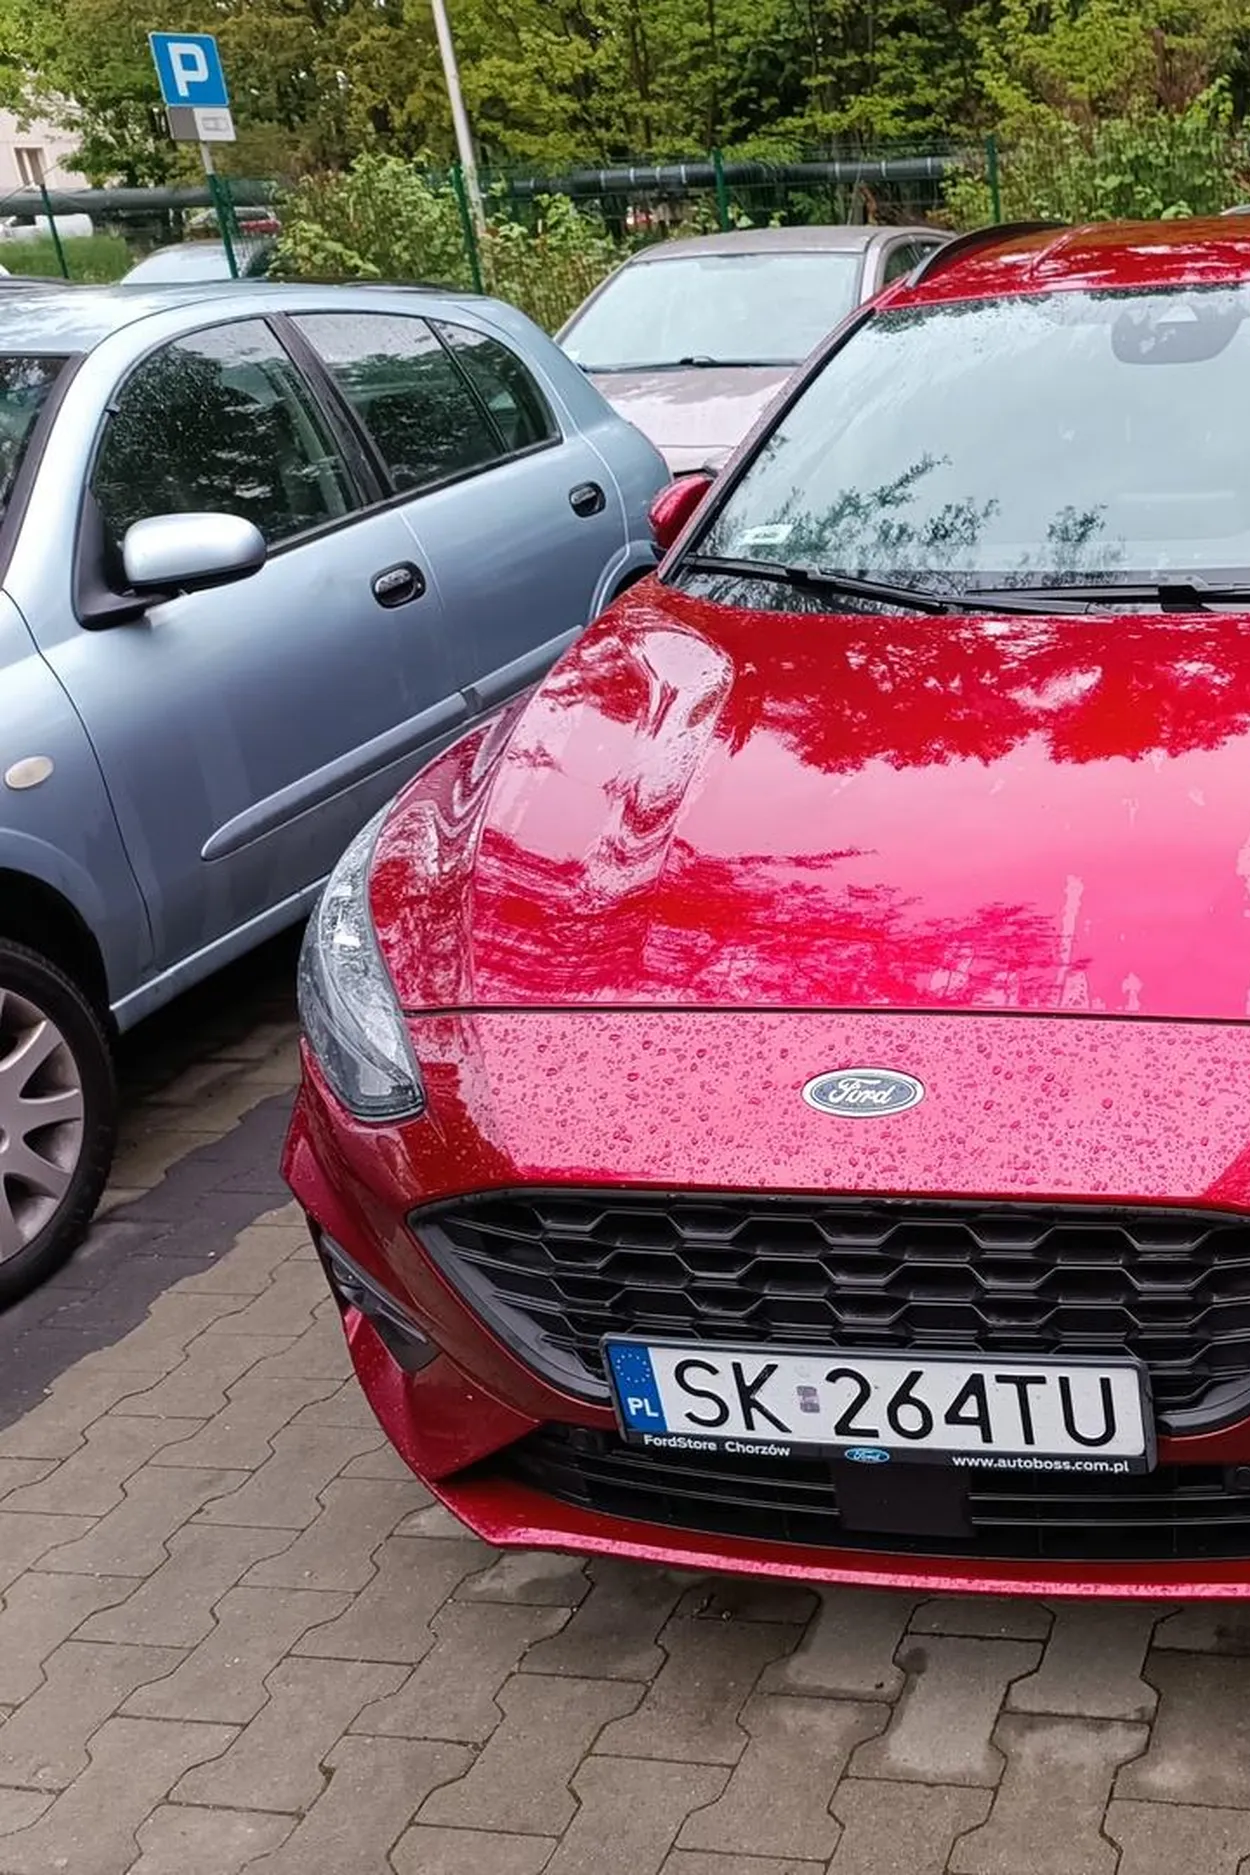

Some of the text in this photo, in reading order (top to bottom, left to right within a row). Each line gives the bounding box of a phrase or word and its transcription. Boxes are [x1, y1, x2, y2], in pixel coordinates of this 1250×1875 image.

[167, 42, 209, 97] P
[828, 1077, 897, 1104] Ford
[628, 1397, 659, 1418] PL
[674, 1358, 1116, 1447] SK 264TU
[643, 1433, 791, 1457] FordStore Chorzów
[952, 1456, 1130, 1473] www.autoboss.com.pl
